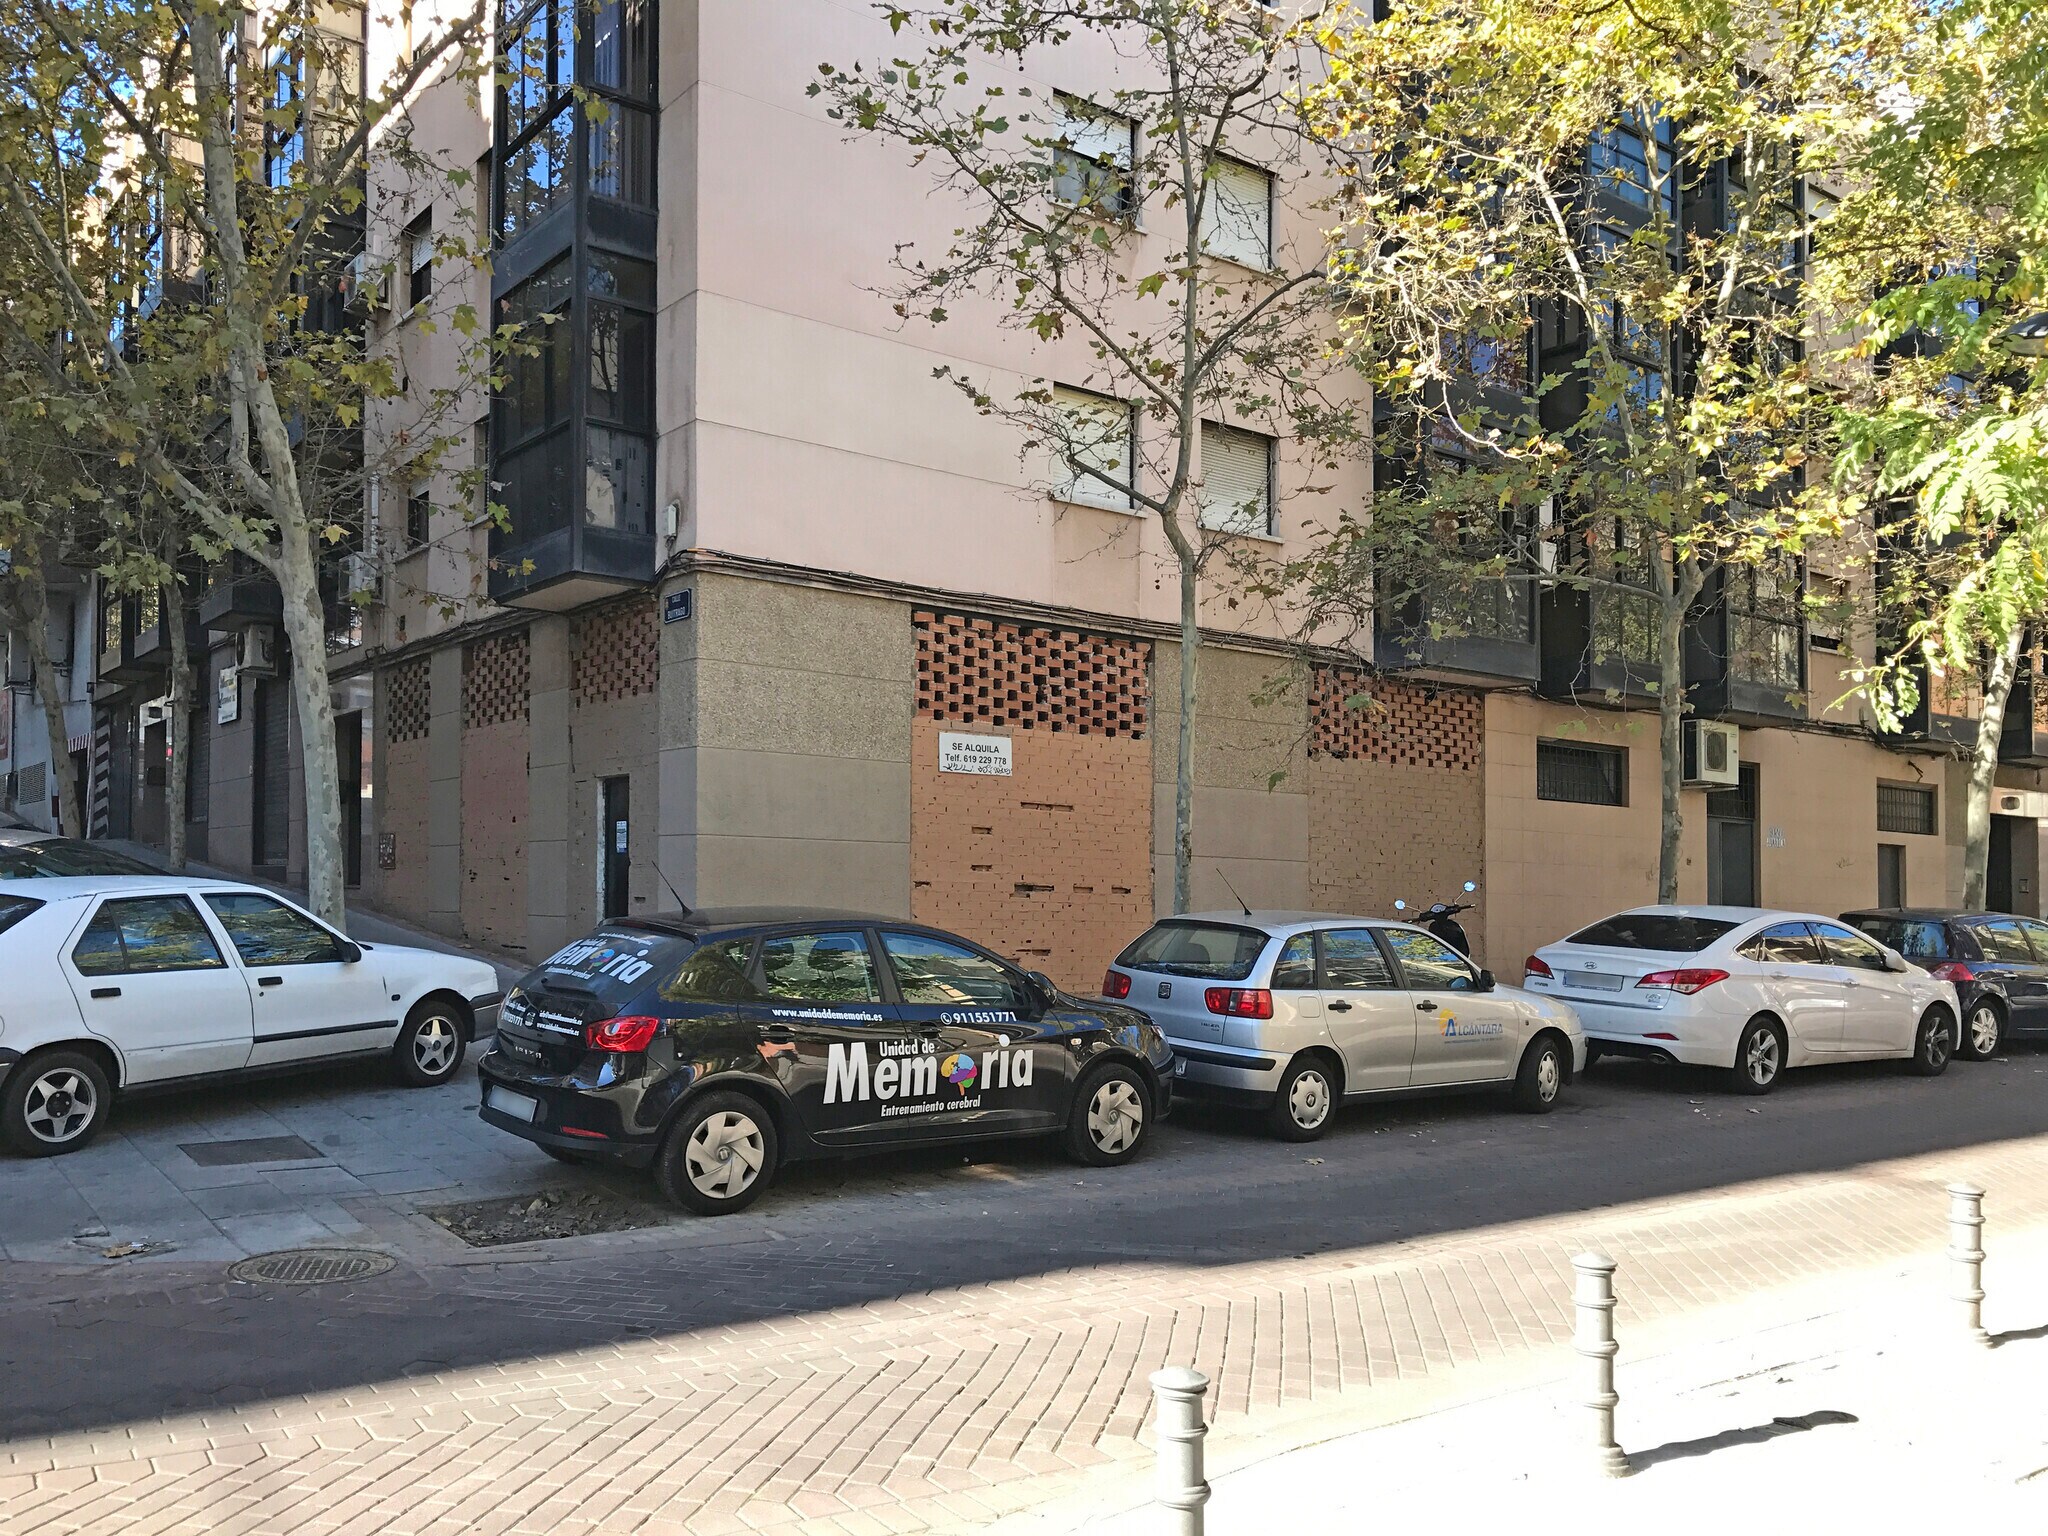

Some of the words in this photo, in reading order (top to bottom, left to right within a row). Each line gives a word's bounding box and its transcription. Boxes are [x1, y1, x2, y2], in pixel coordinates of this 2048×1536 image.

[952, 742, 963, 751] SE
[965, 744, 1000, 753] ALQUILA
[945, 753, 962, 763] Telf.
[963, 755, 977, 763] 619
[978, 756, 992, 764] 229
[994, 757, 1007, 765] 778
[772, 1008, 883, 1021] www.unidaddememoria.es
[953, 1011, 1017, 1024] 911551771
[879, 1038, 919, 1057] Unidad
[921, 1038, 935, 1054] de
[880, 1101, 945, 1117] Entrenamiento
[946, 1095, 981, 1112] cerebral
